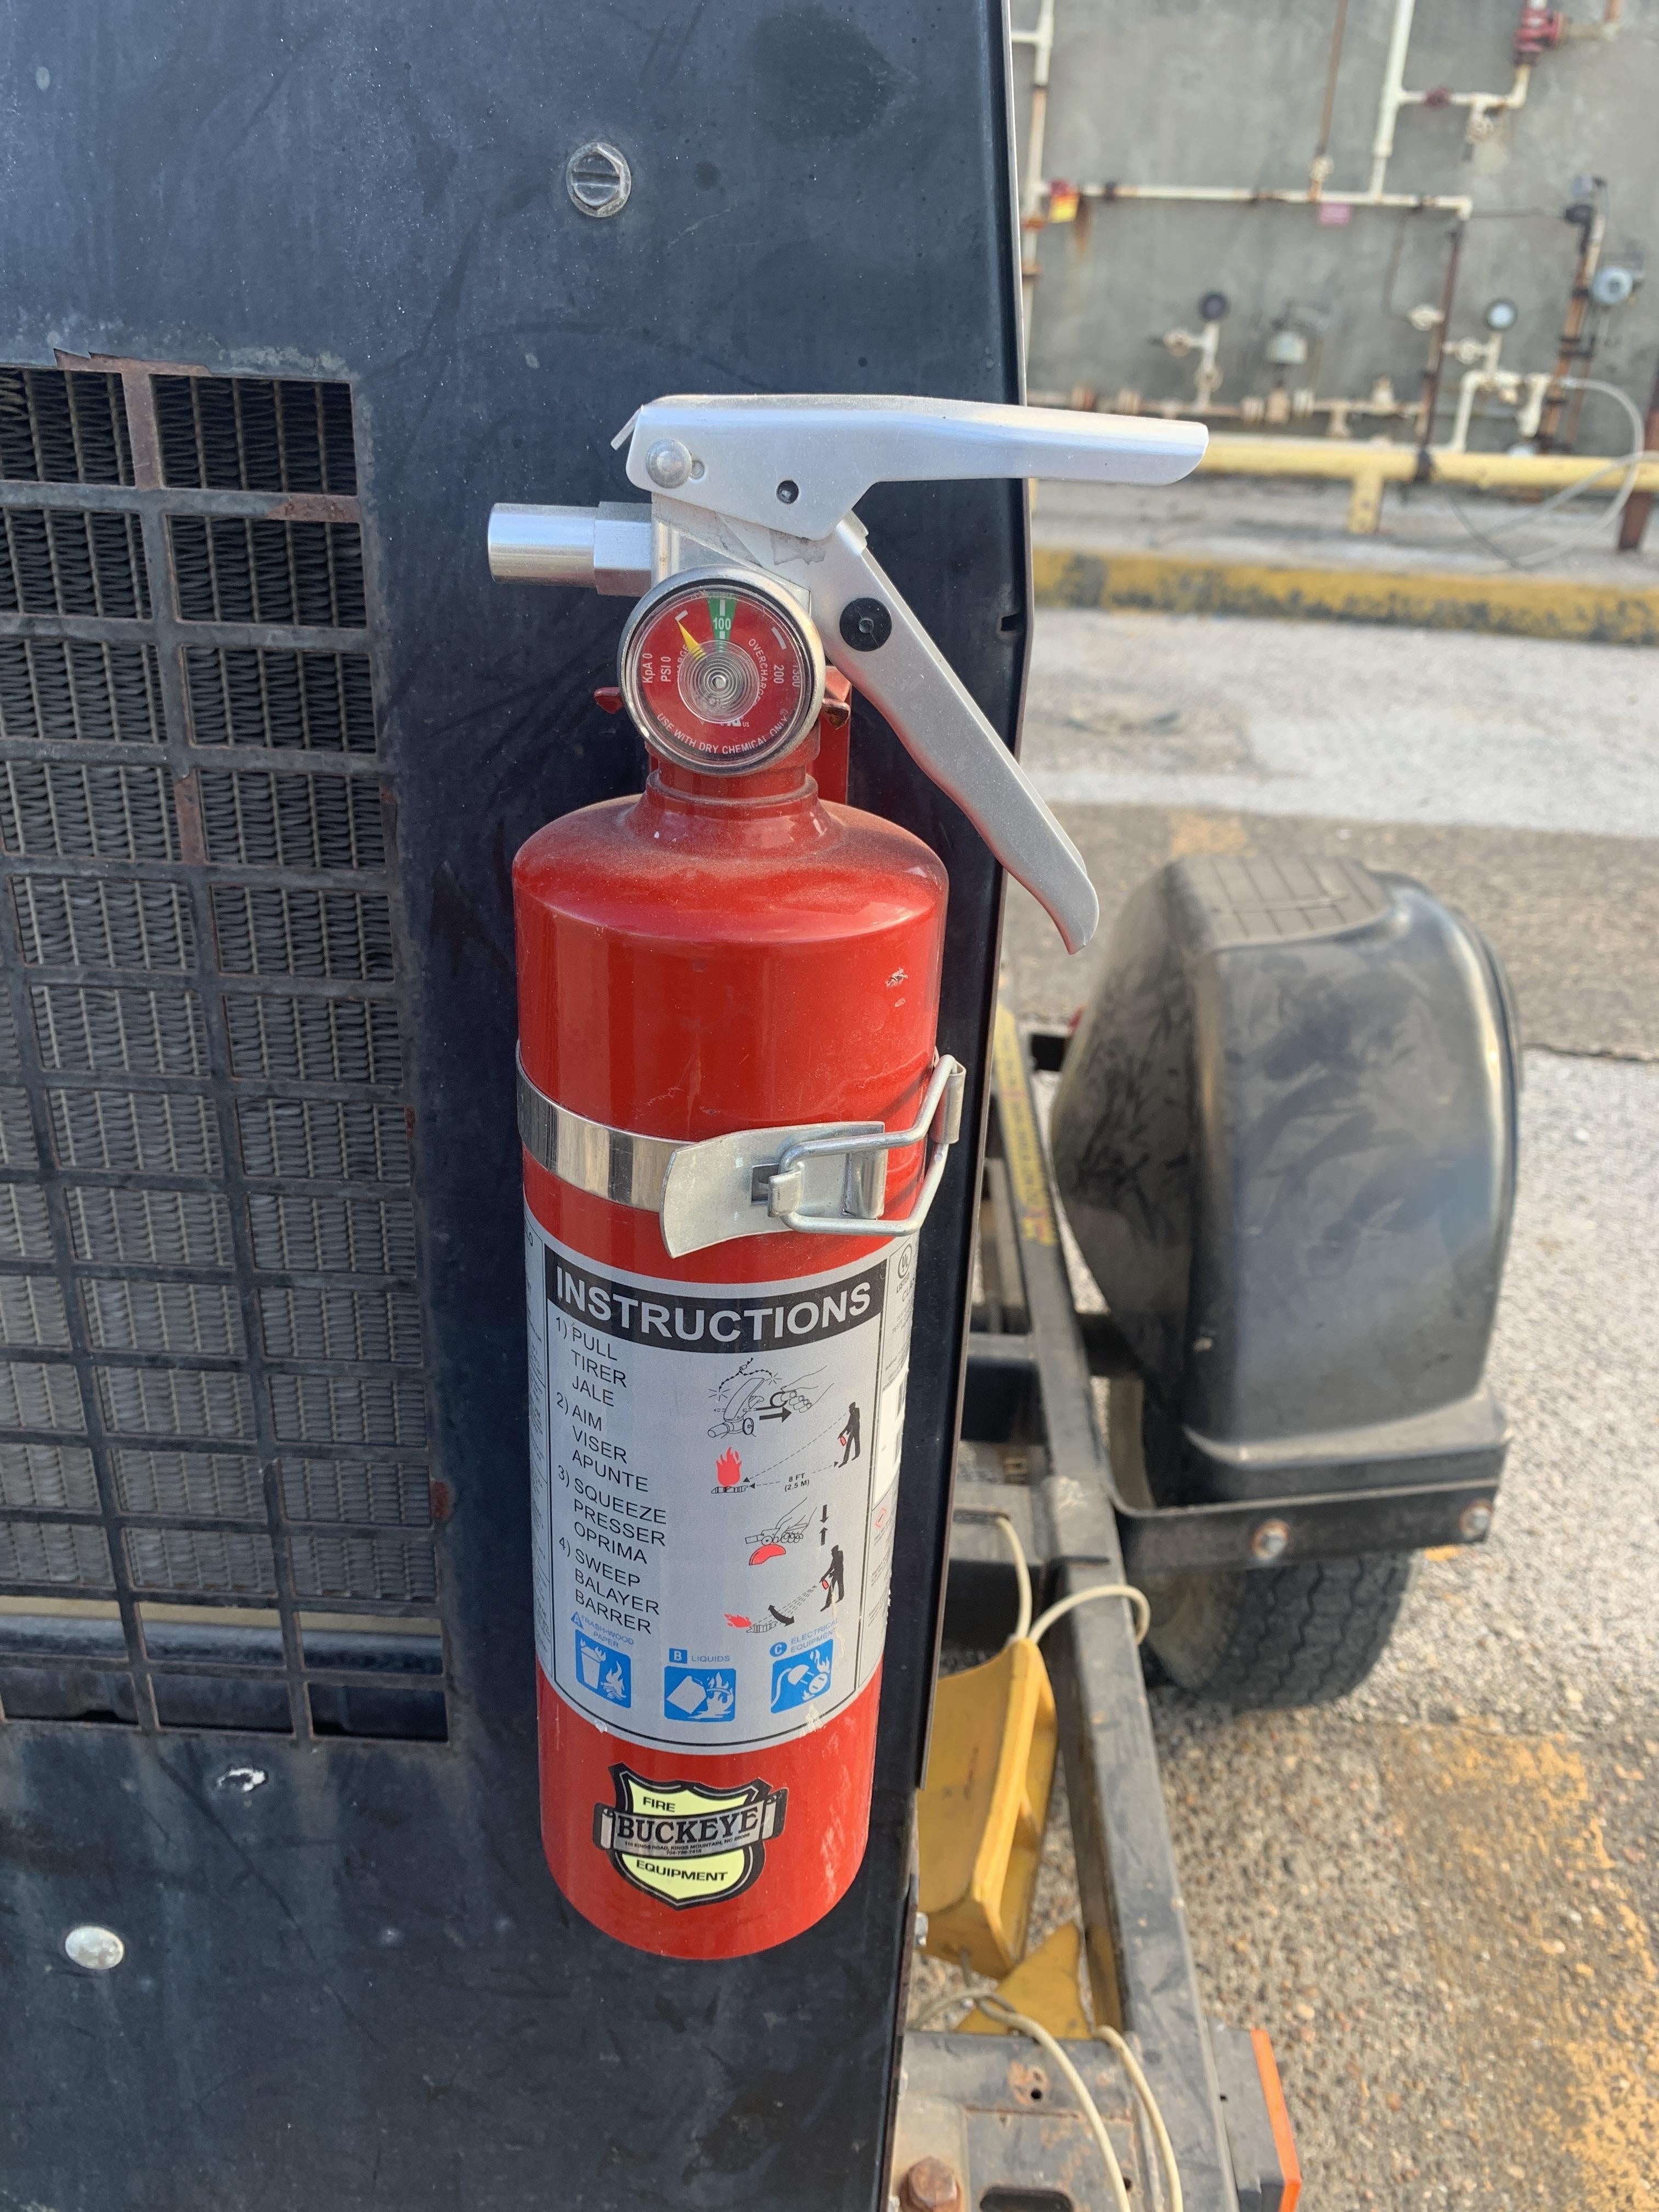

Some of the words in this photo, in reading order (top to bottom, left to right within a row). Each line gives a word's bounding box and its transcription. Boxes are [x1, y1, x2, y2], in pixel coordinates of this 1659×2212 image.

[713, 617, 731, 631] 100
[642, 662, 656, 684] KpA
[661, 665, 672, 682] PSI
[773, 664, 785, 684] 200
[657, 713, 675, 732] USE
[674, 729, 697, 748] WITH
[698, 742, 719, 754] DRY
[722, 735, 767, 754] CHEMICAL
[556, 1266, 871, 1342] INSTRUCTIONS
[556, 1317, 567, 1339] 1)
[572, 1327, 617, 1361] PULL
[571, 1349, 627, 1388] TIRER
[572, 1375, 614, 1407] JALE
[557, 1392, 568, 1415] 2)
[572, 1404, 602, 1431] AIM
[572, 1425, 627, 1464] VISER
[572, 1449, 648, 1492] APUNTE
[785, 1482, 799, 1492] (2.5
[558, 1465, 569, 1487] 3)
[574, 1478, 666, 1525] SQUEEZE
[574, 1498, 665, 1547] PRESSER
[559, 1537, 571, 1557] 4)
[575, 1548, 640, 1587] SWEEP
[574, 1521, 648, 1565] OPRIMA
[575, 1567, 660, 1615] BALAYER
[575, 1588, 652, 1634] BARRER
[593, 1630, 619, 1648] PAPER
[791, 1618, 838, 1645] ELECTRICAL
[791, 1628, 834, 1653] EQUIPMEN
[643, 1796, 676, 1813] FIRE
[617, 1807, 758, 1844] BUCKEYE
[690, 1841, 724, 1849] MOUNTAIN,
[636, 1859, 729, 1882] EQUIPMENT
